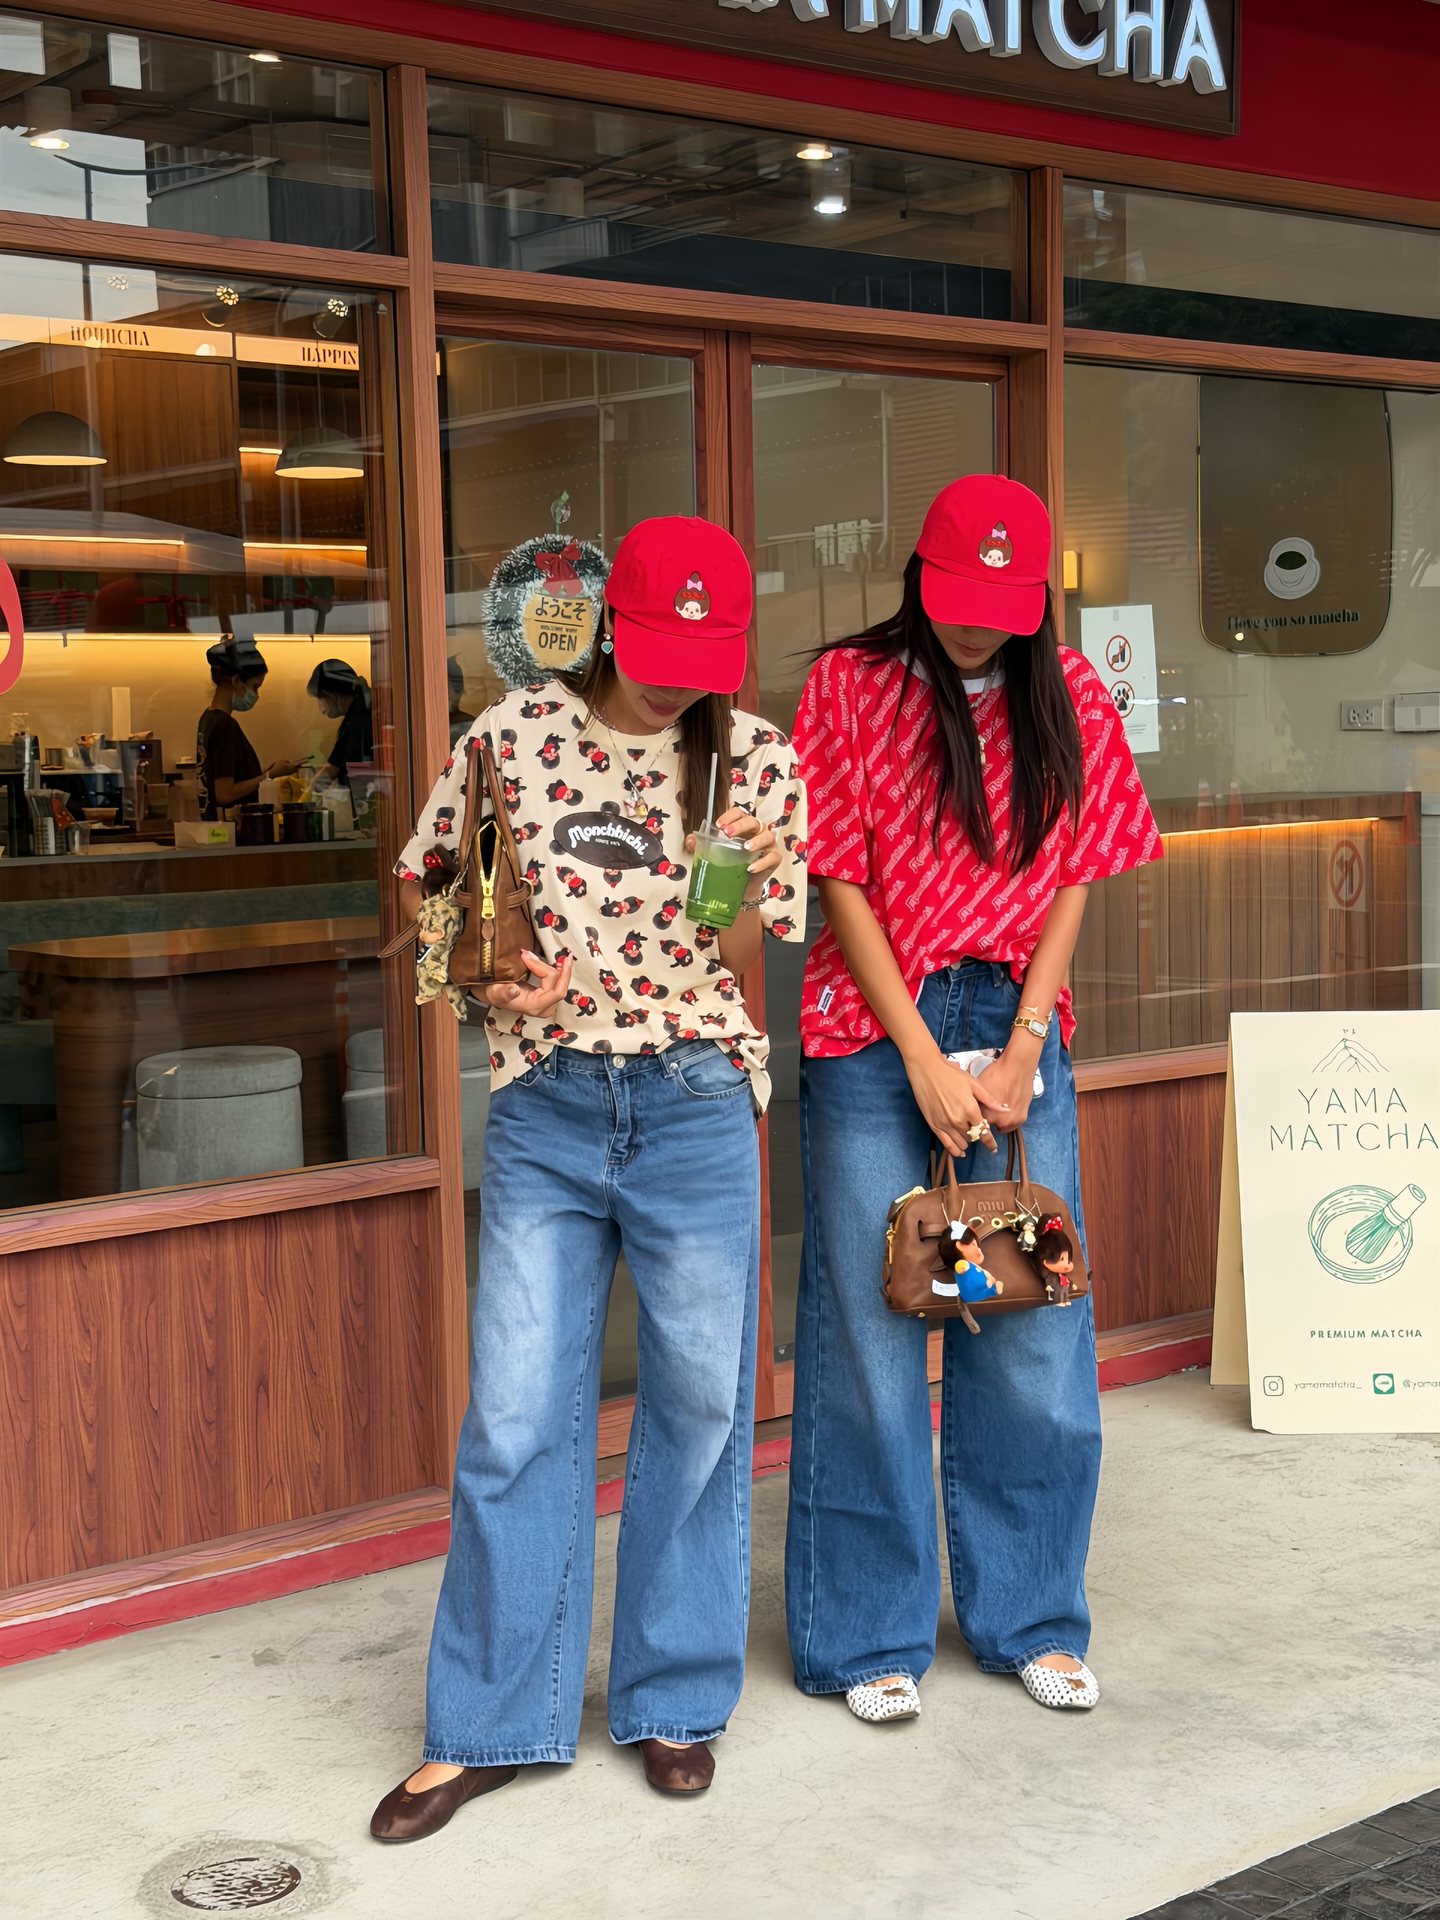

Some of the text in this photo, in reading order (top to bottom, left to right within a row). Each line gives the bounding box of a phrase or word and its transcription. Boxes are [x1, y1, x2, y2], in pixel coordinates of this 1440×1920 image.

[535, 597, 586, 621] ようこそ
[1264, 617, 1288, 631] you
[1291, 616, 1306, 625] so
[1309, 608, 1360, 624] matcha
[538, 632, 578, 652] OPEN
[1297, 1087, 1408, 1114] YAMA
[1270, 1122, 1440, 1151] MATCHA
[1310, 1329, 1423, 1339] PREMIUM MATCHA
